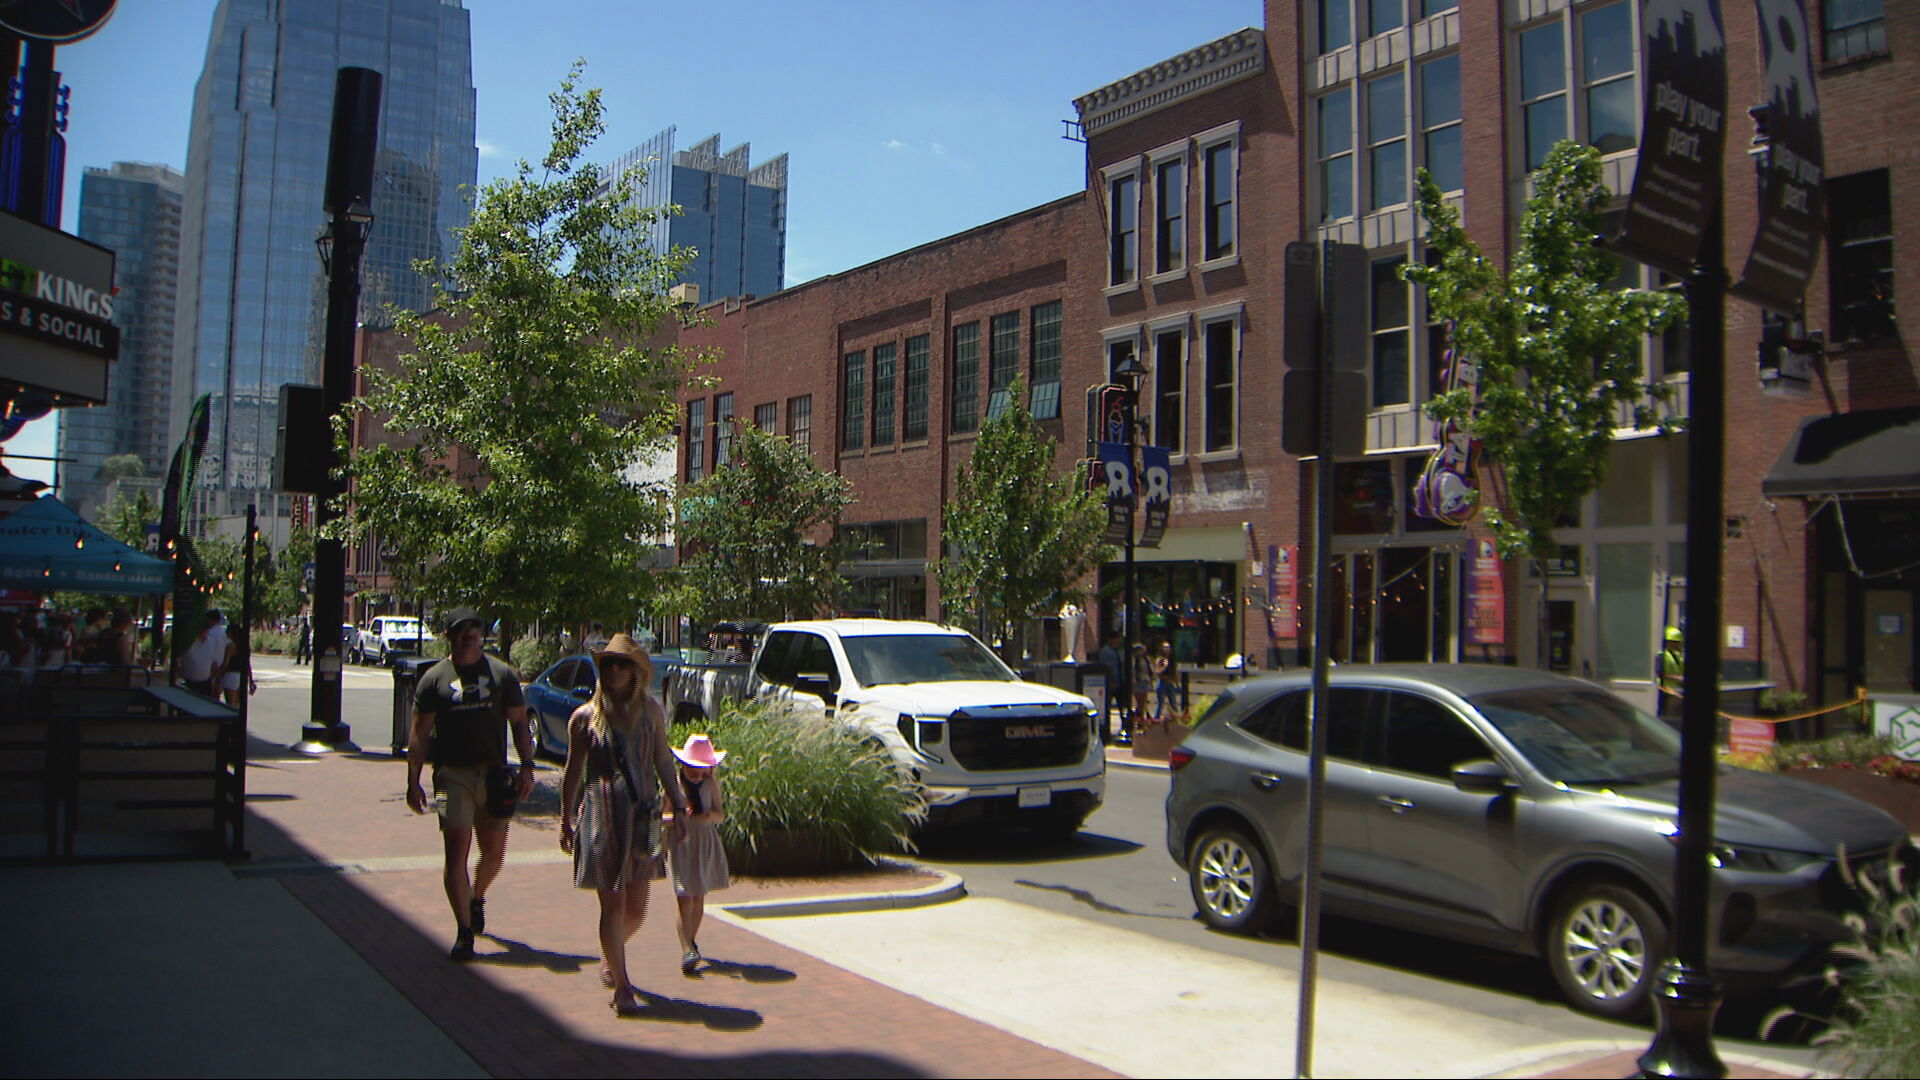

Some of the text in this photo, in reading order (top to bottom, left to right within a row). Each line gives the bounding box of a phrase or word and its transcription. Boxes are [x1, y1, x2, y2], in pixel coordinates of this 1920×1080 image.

[1655, 80, 1721, 133] play your
[20, 307, 32, 327] &
[39, 312, 105, 348] SOCIAL
